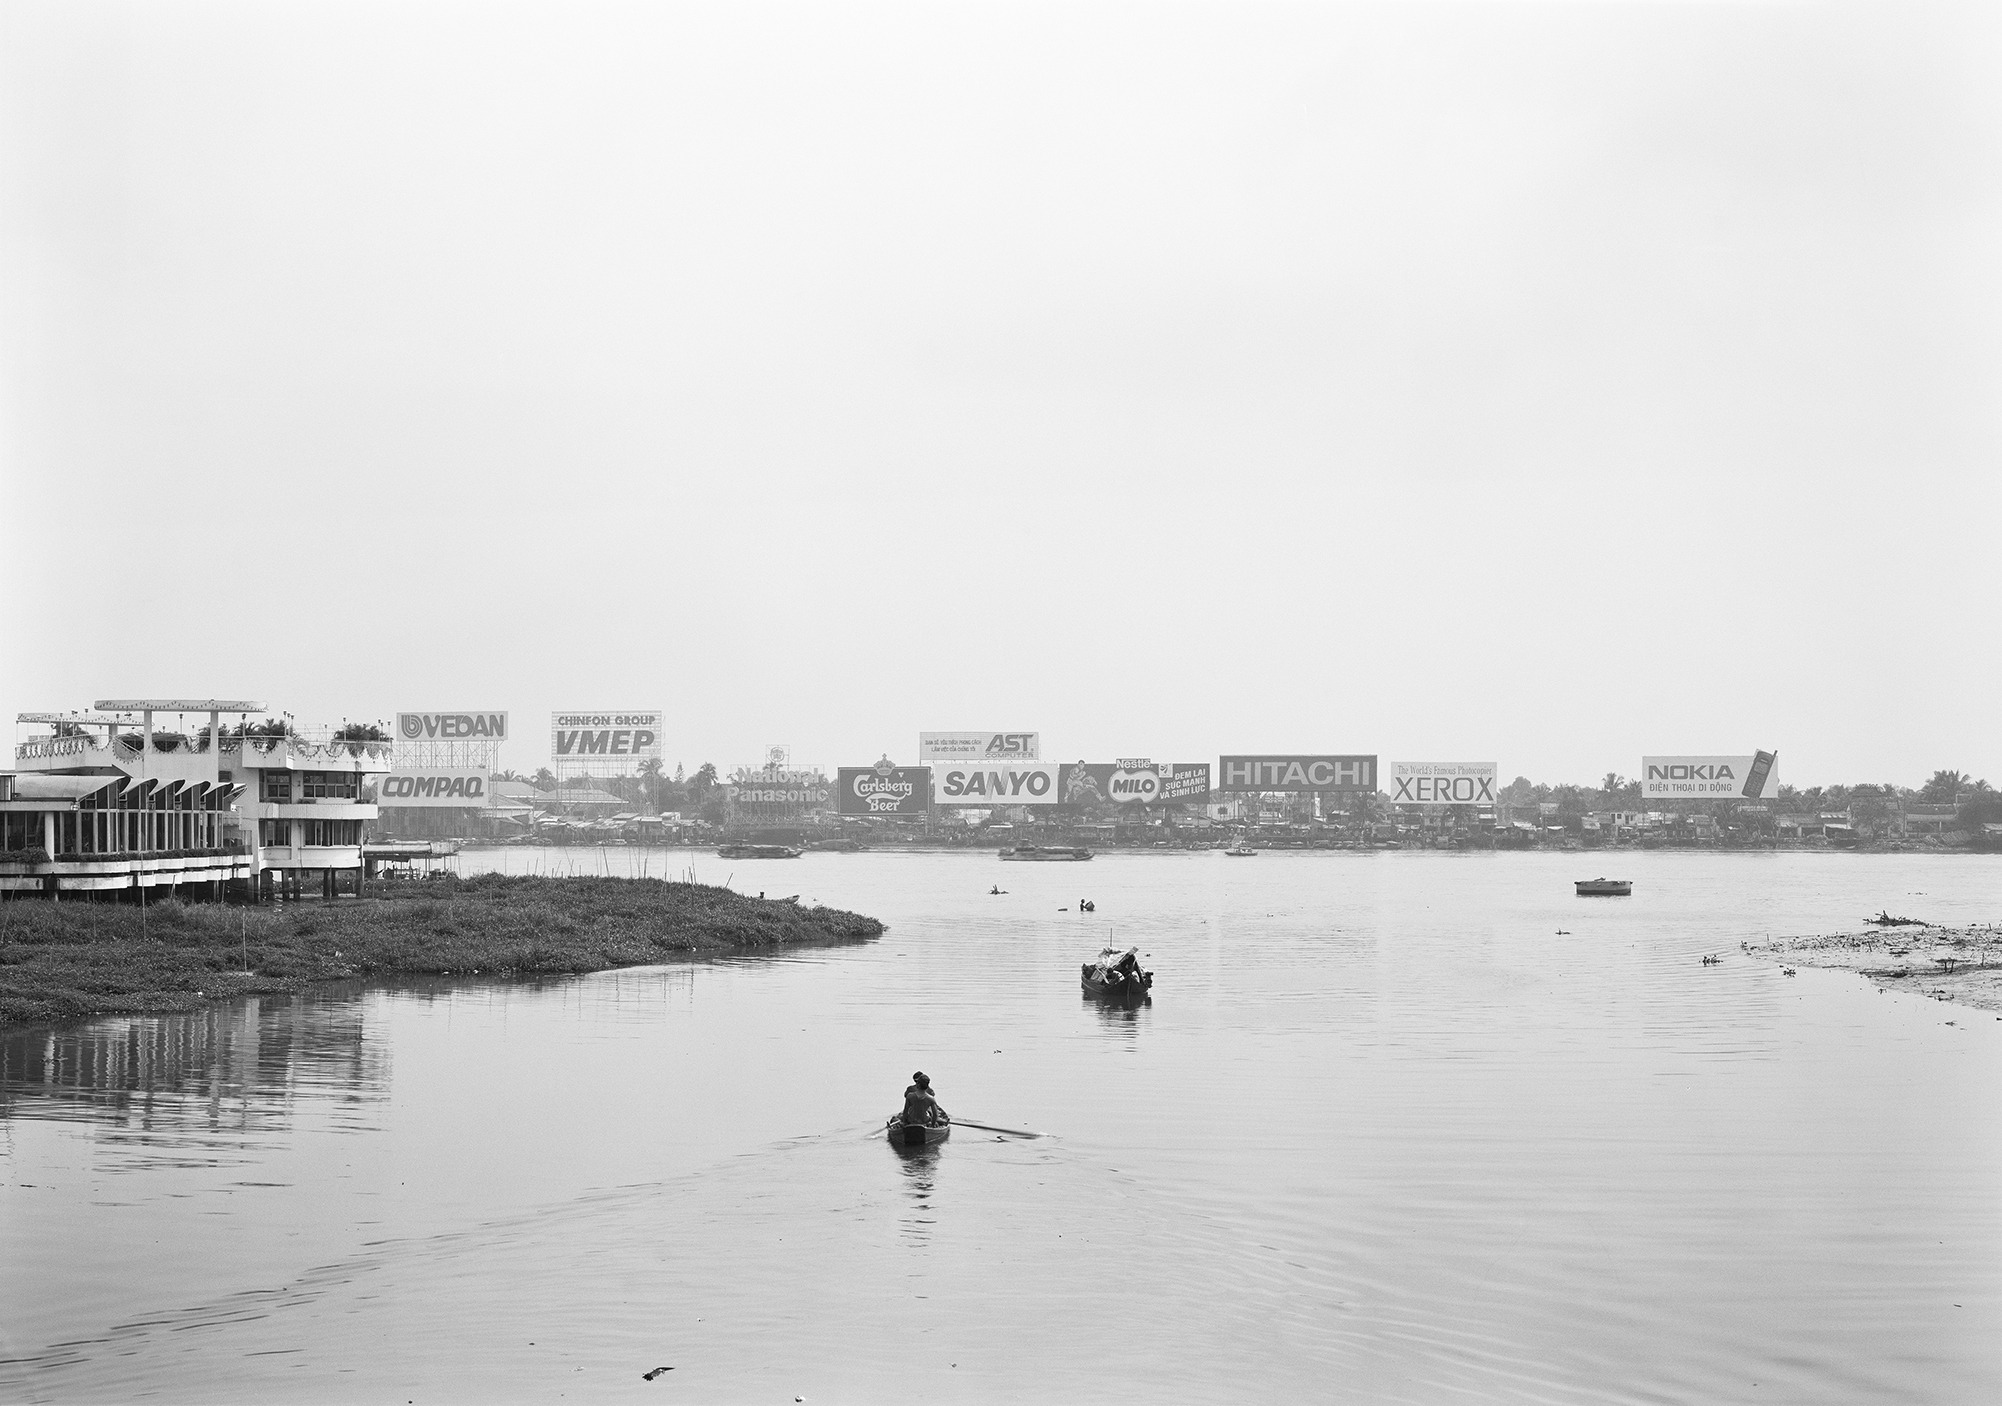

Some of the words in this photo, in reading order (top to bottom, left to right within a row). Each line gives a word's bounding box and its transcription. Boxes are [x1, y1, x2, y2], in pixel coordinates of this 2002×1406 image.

[422, 714, 504, 738] VEDAN
[558, 715, 611, 726] CHINFON
[614, 715, 656, 726] GROUP
[556, 730, 655, 755] VMEP
[736, 767, 820, 783] National
[1226, 761, 1370, 785] HITACHI
[1398, 765, 1408, 775] The
[1433, 765, 1456, 775] Famous
[1648, 765, 1735, 780] NOKIA
[382, 776, 484, 799] COMPAQ
[853, 774, 913, 798] Carlsberg
[943, 767, 1051, 799] SANYO
[1112, 779, 1155, 793] MILO
[1393, 777, 1494, 801] XEROX
[1649, 781, 1669, 793] ĐIỆN
[1671, 783, 1696, 793] THOẠI
[1698, 783, 1707, 792] DI
[1709, 781, 1732, 793] ĐỘNG
[726, 786, 829, 802] Panasonic
[1171, 787, 1190, 798] SINH
[869, 798, 901, 812] Beer
